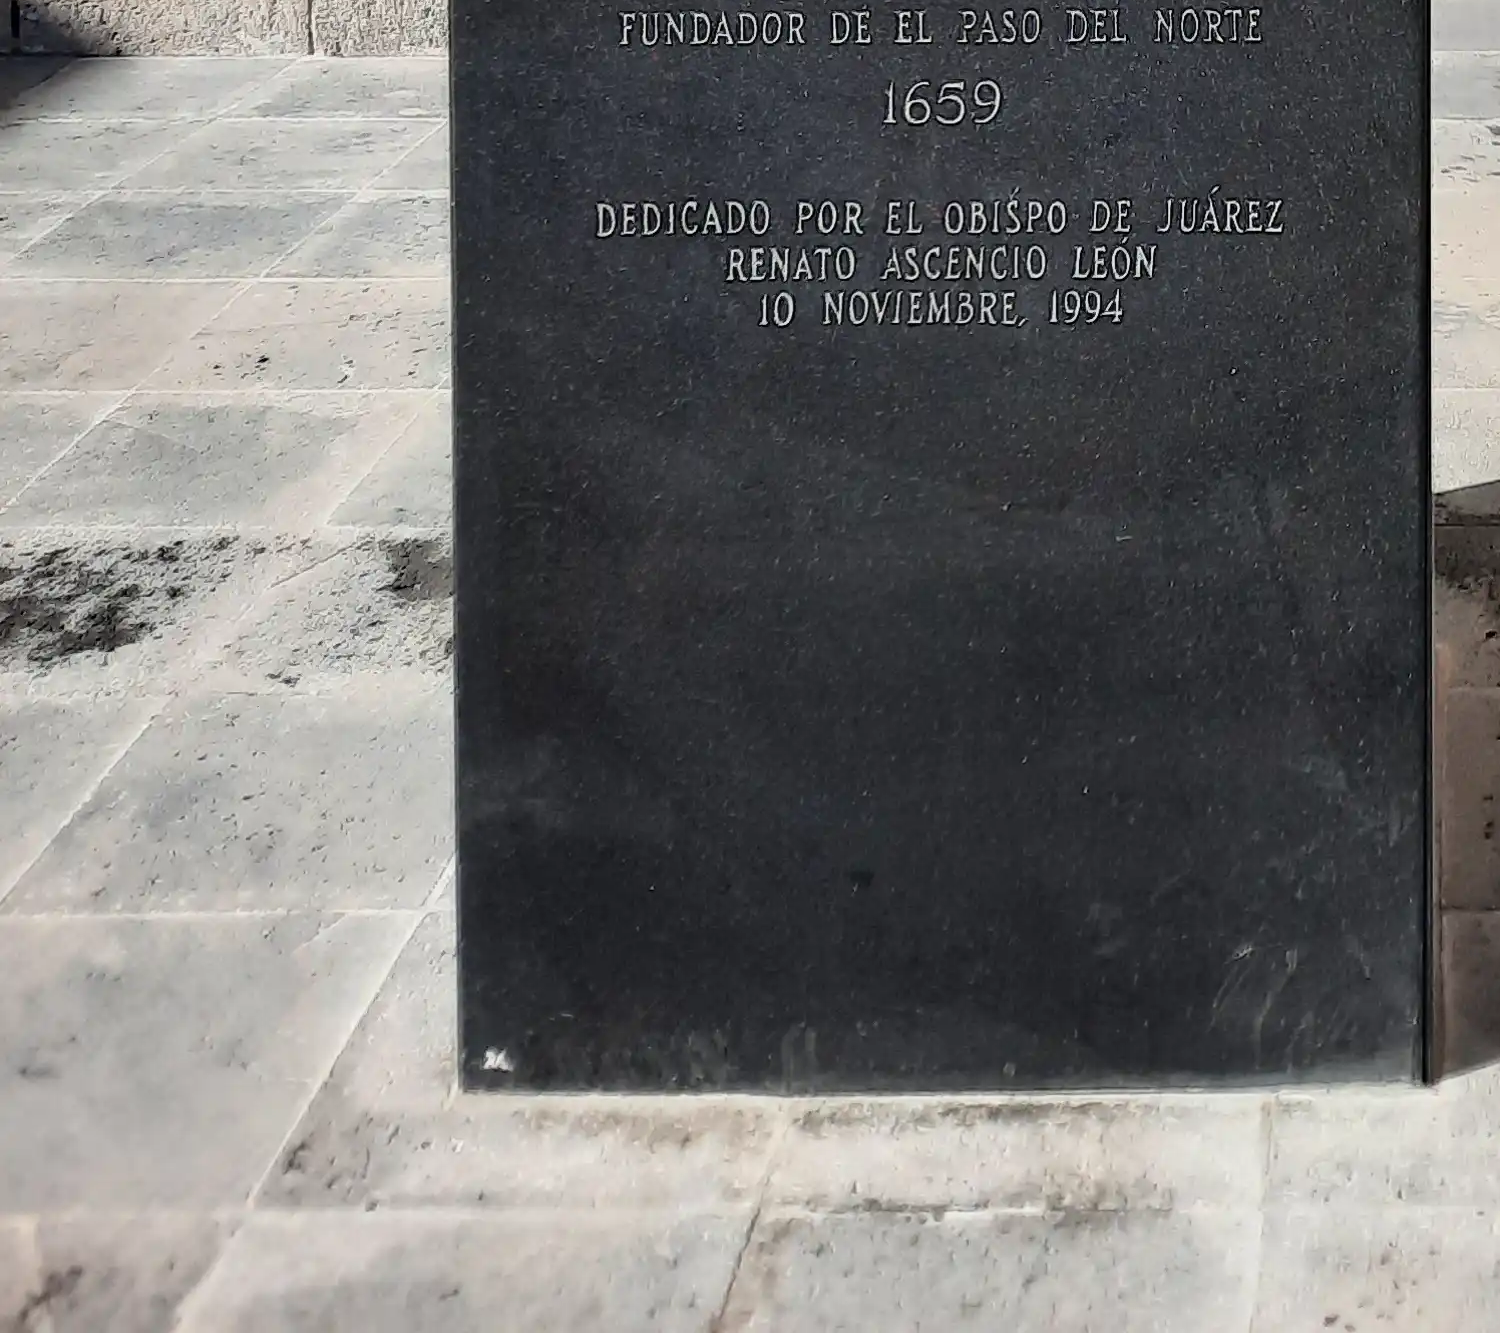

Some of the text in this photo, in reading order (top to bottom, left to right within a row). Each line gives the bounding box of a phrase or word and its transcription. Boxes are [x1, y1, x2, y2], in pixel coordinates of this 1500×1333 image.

[618, 8, 1263, 46] FUNDADOR DE EL PASO DEL NORTE
[883, 79, 1002, 124] 1659
[596, 200, 771, 238] DEDICADO
[796, 200, 865, 235] POR
[885, 201, 924, 235] EL
[1089, 199, 1132, 233] DE
[1157, 187, 1284, 233] JUÁREZ
[725, 236, 1157, 281] RENATO ASCENCIO LEÓN
[758, 288, 1124, 330] 10 NOVIEMBRE, 1994
